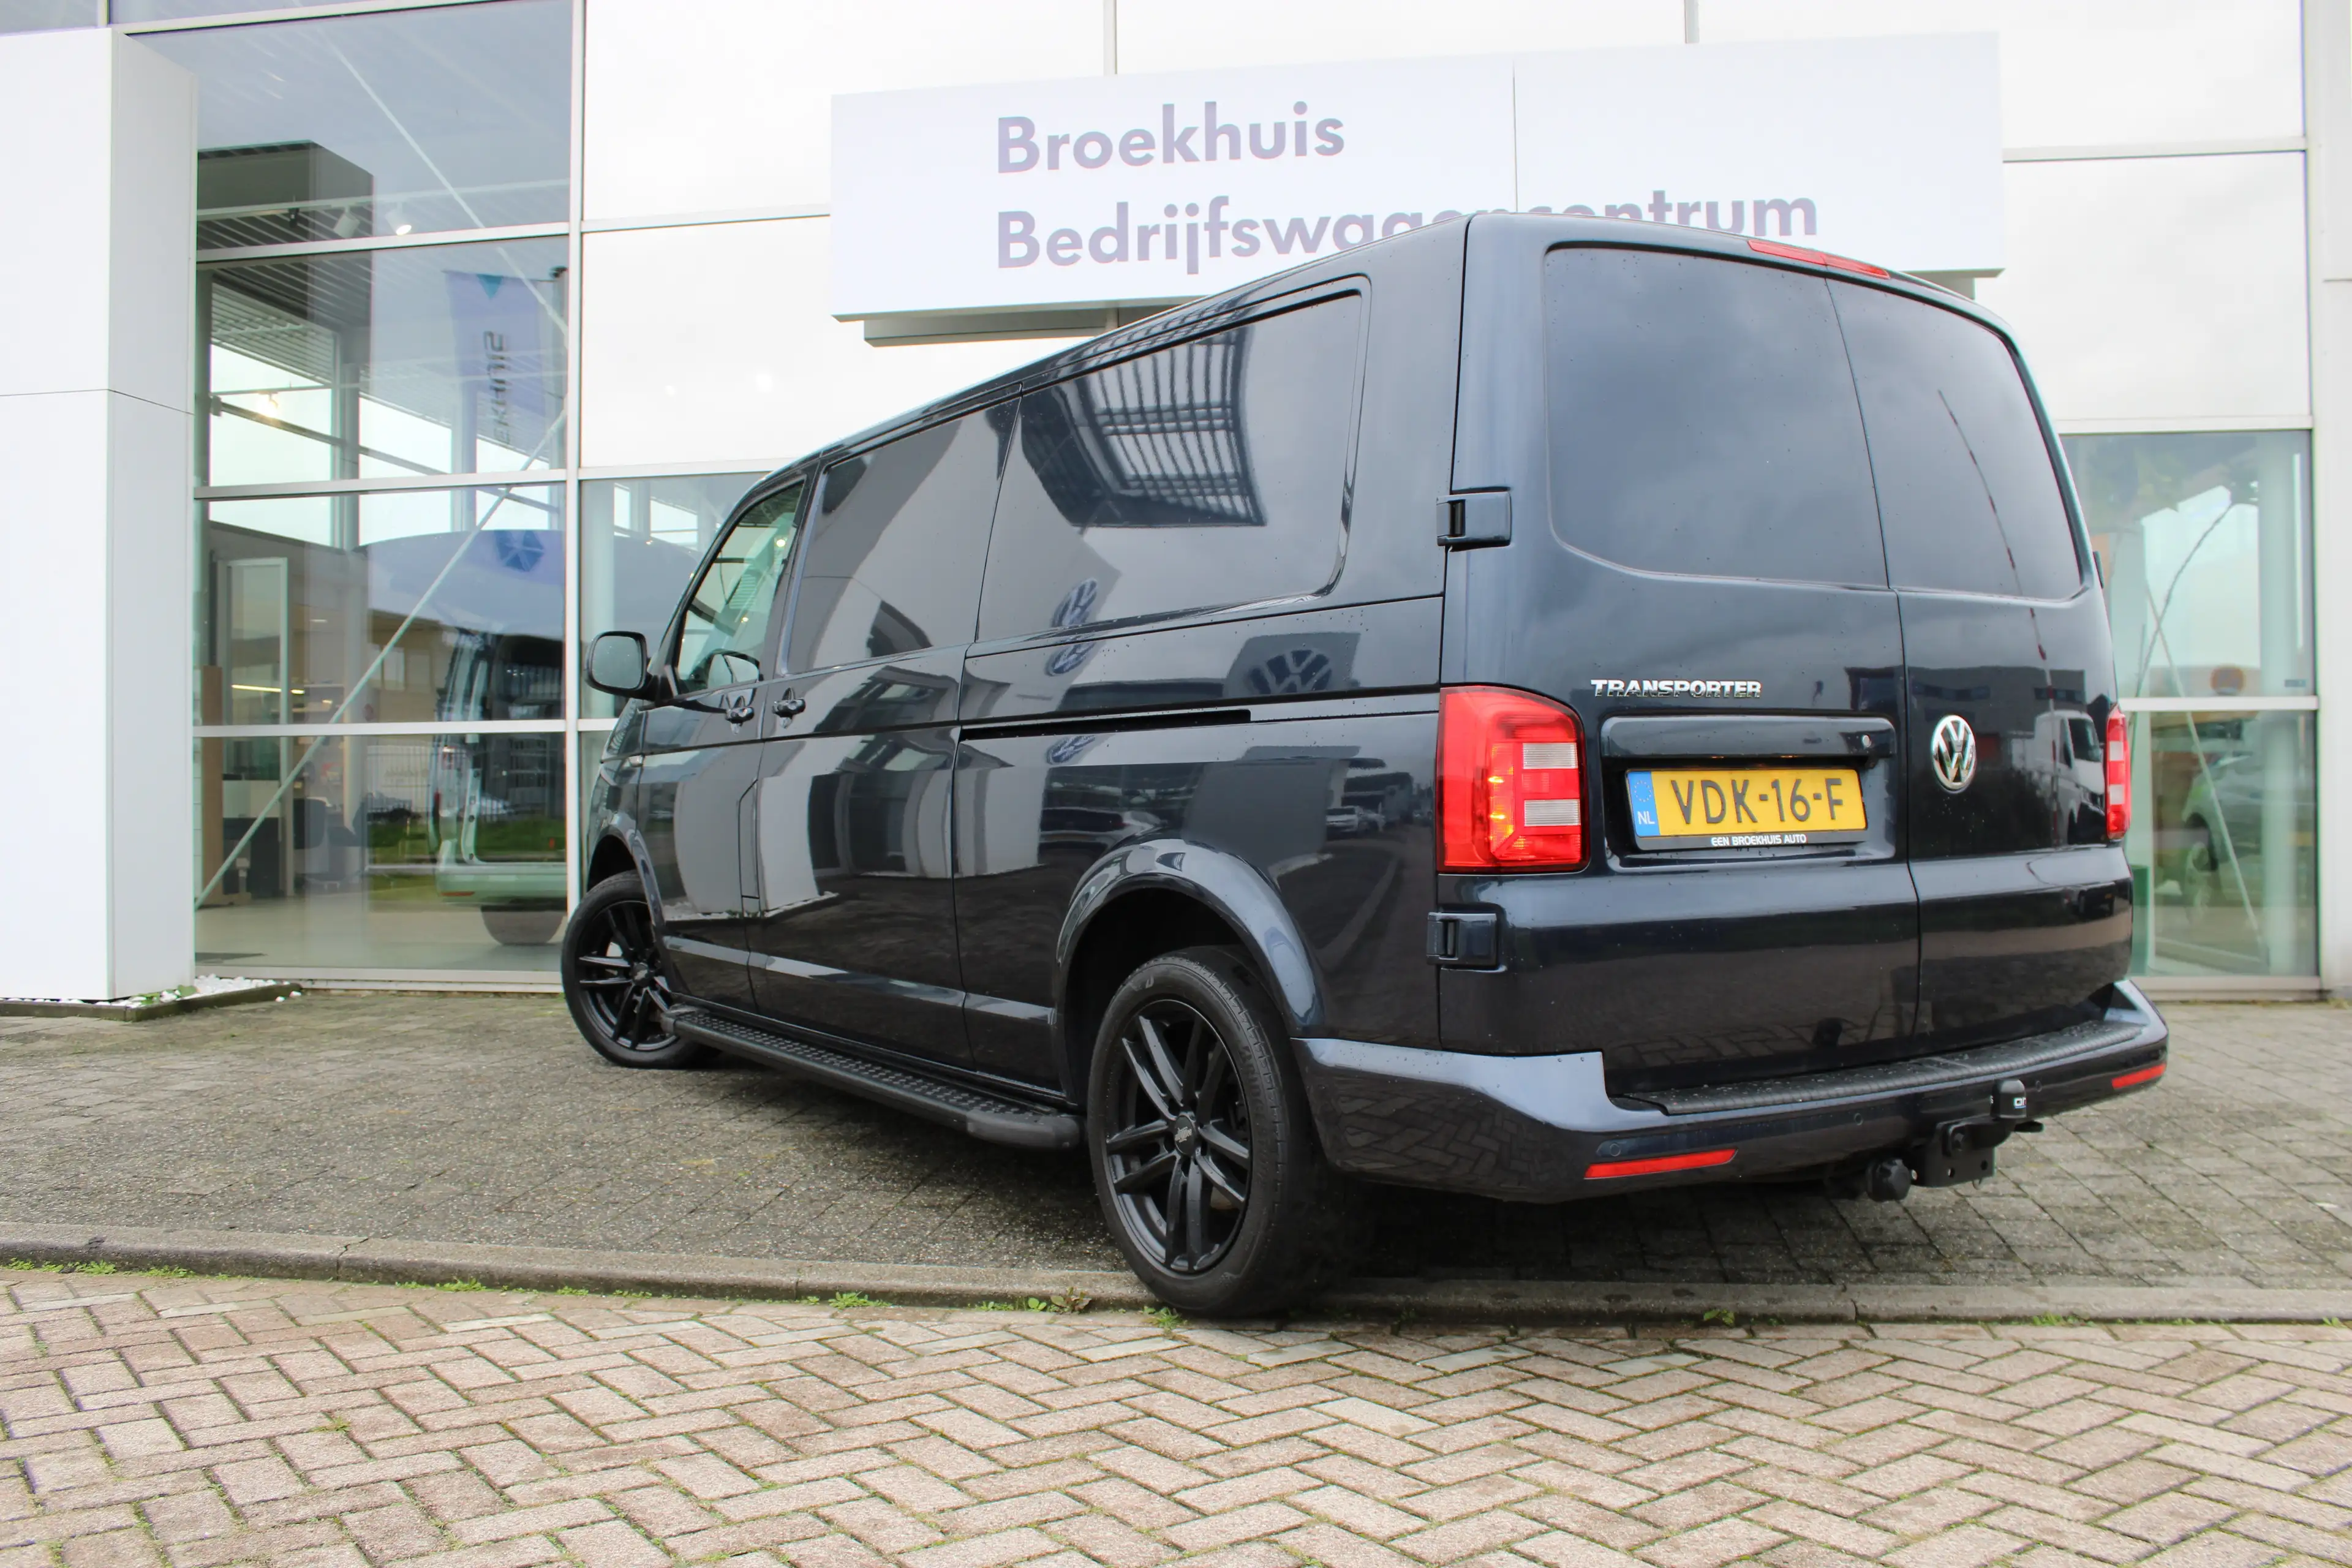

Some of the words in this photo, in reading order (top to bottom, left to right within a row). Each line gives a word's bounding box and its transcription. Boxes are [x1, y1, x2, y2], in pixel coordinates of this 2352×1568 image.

[998, 100, 1345, 173] Broekhuis
[998, 189, 1817, 275] Bedrijfswatrum
[1590, 679, 1762, 698] TRANSPORTER
[1637, 810, 1656, 825] NL
[1670, 778, 1844, 825] VDK-16-F
[1711, 837, 1730, 846] EEN
[1732, 834, 1782, 846] BROEKHUIS
[1783, 833, 1807, 844] AUTO
